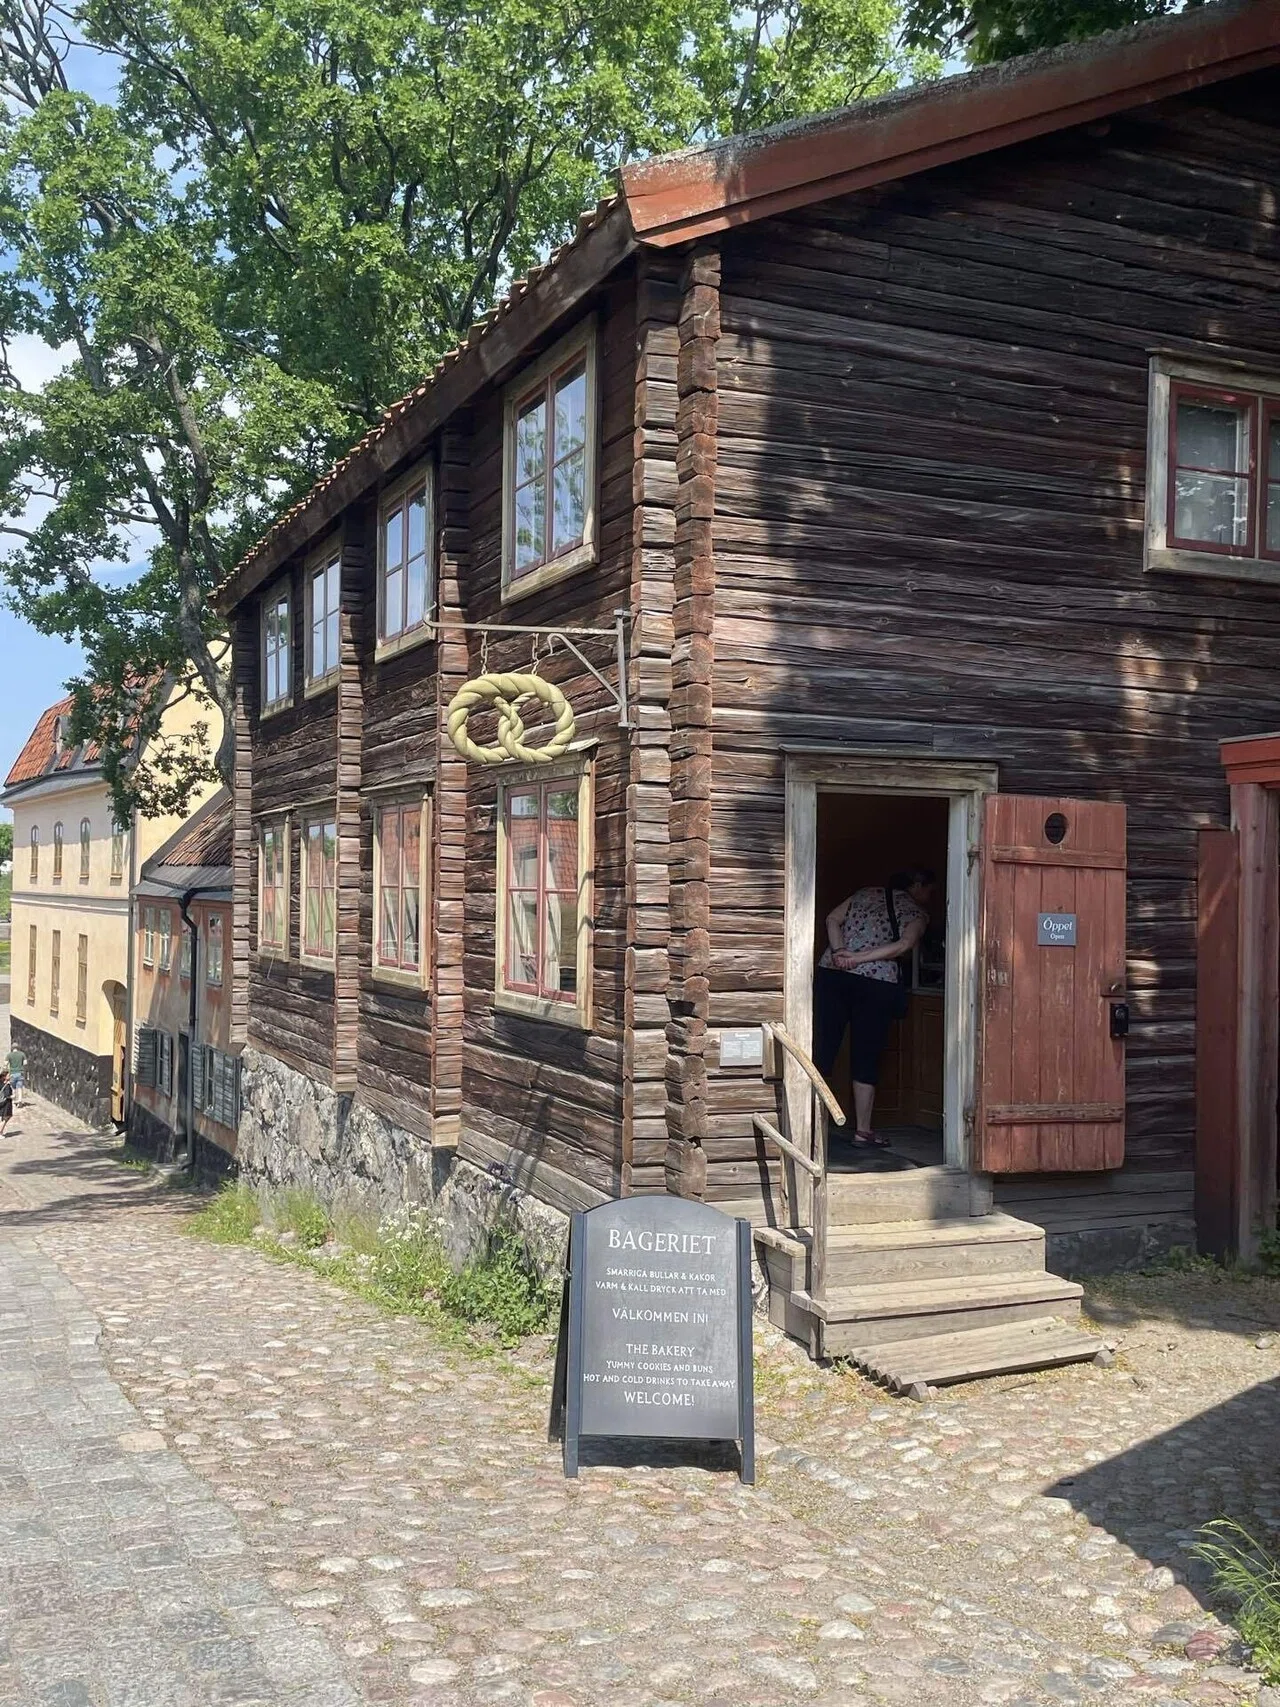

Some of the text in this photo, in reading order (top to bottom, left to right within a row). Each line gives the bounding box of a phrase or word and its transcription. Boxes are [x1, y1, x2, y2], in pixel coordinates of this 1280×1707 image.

[1043, 917, 1073, 932] Öppet
[608, 1229, 716, 1255] BAGERIET
[650, 1271, 680, 1280] BULLAR
[681, 1272, 687, 1280] &
[689, 1273, 716, 1282] KAKOR
[595, 1281, 727, 1296] VARM & KALL DRYCK ATT TA MED
[612, 1306, 688, 1323] VÄLKOMMEN
[626, 1343, 695, 1357] THE BAKERY
[606, 1360, 714, 1374] YUMMY COOKIES AND BUNS
[583, 1373, 601, 1382] HOT
[603, 1375, 620, 1383] AND
[622, 1375, 643, 1384] COLD
[645, 1377, 675, 1386] DRINKS
[677, 1378, 689, 1386] TO
[624, 1391, 695, 1406] WELCOME!
